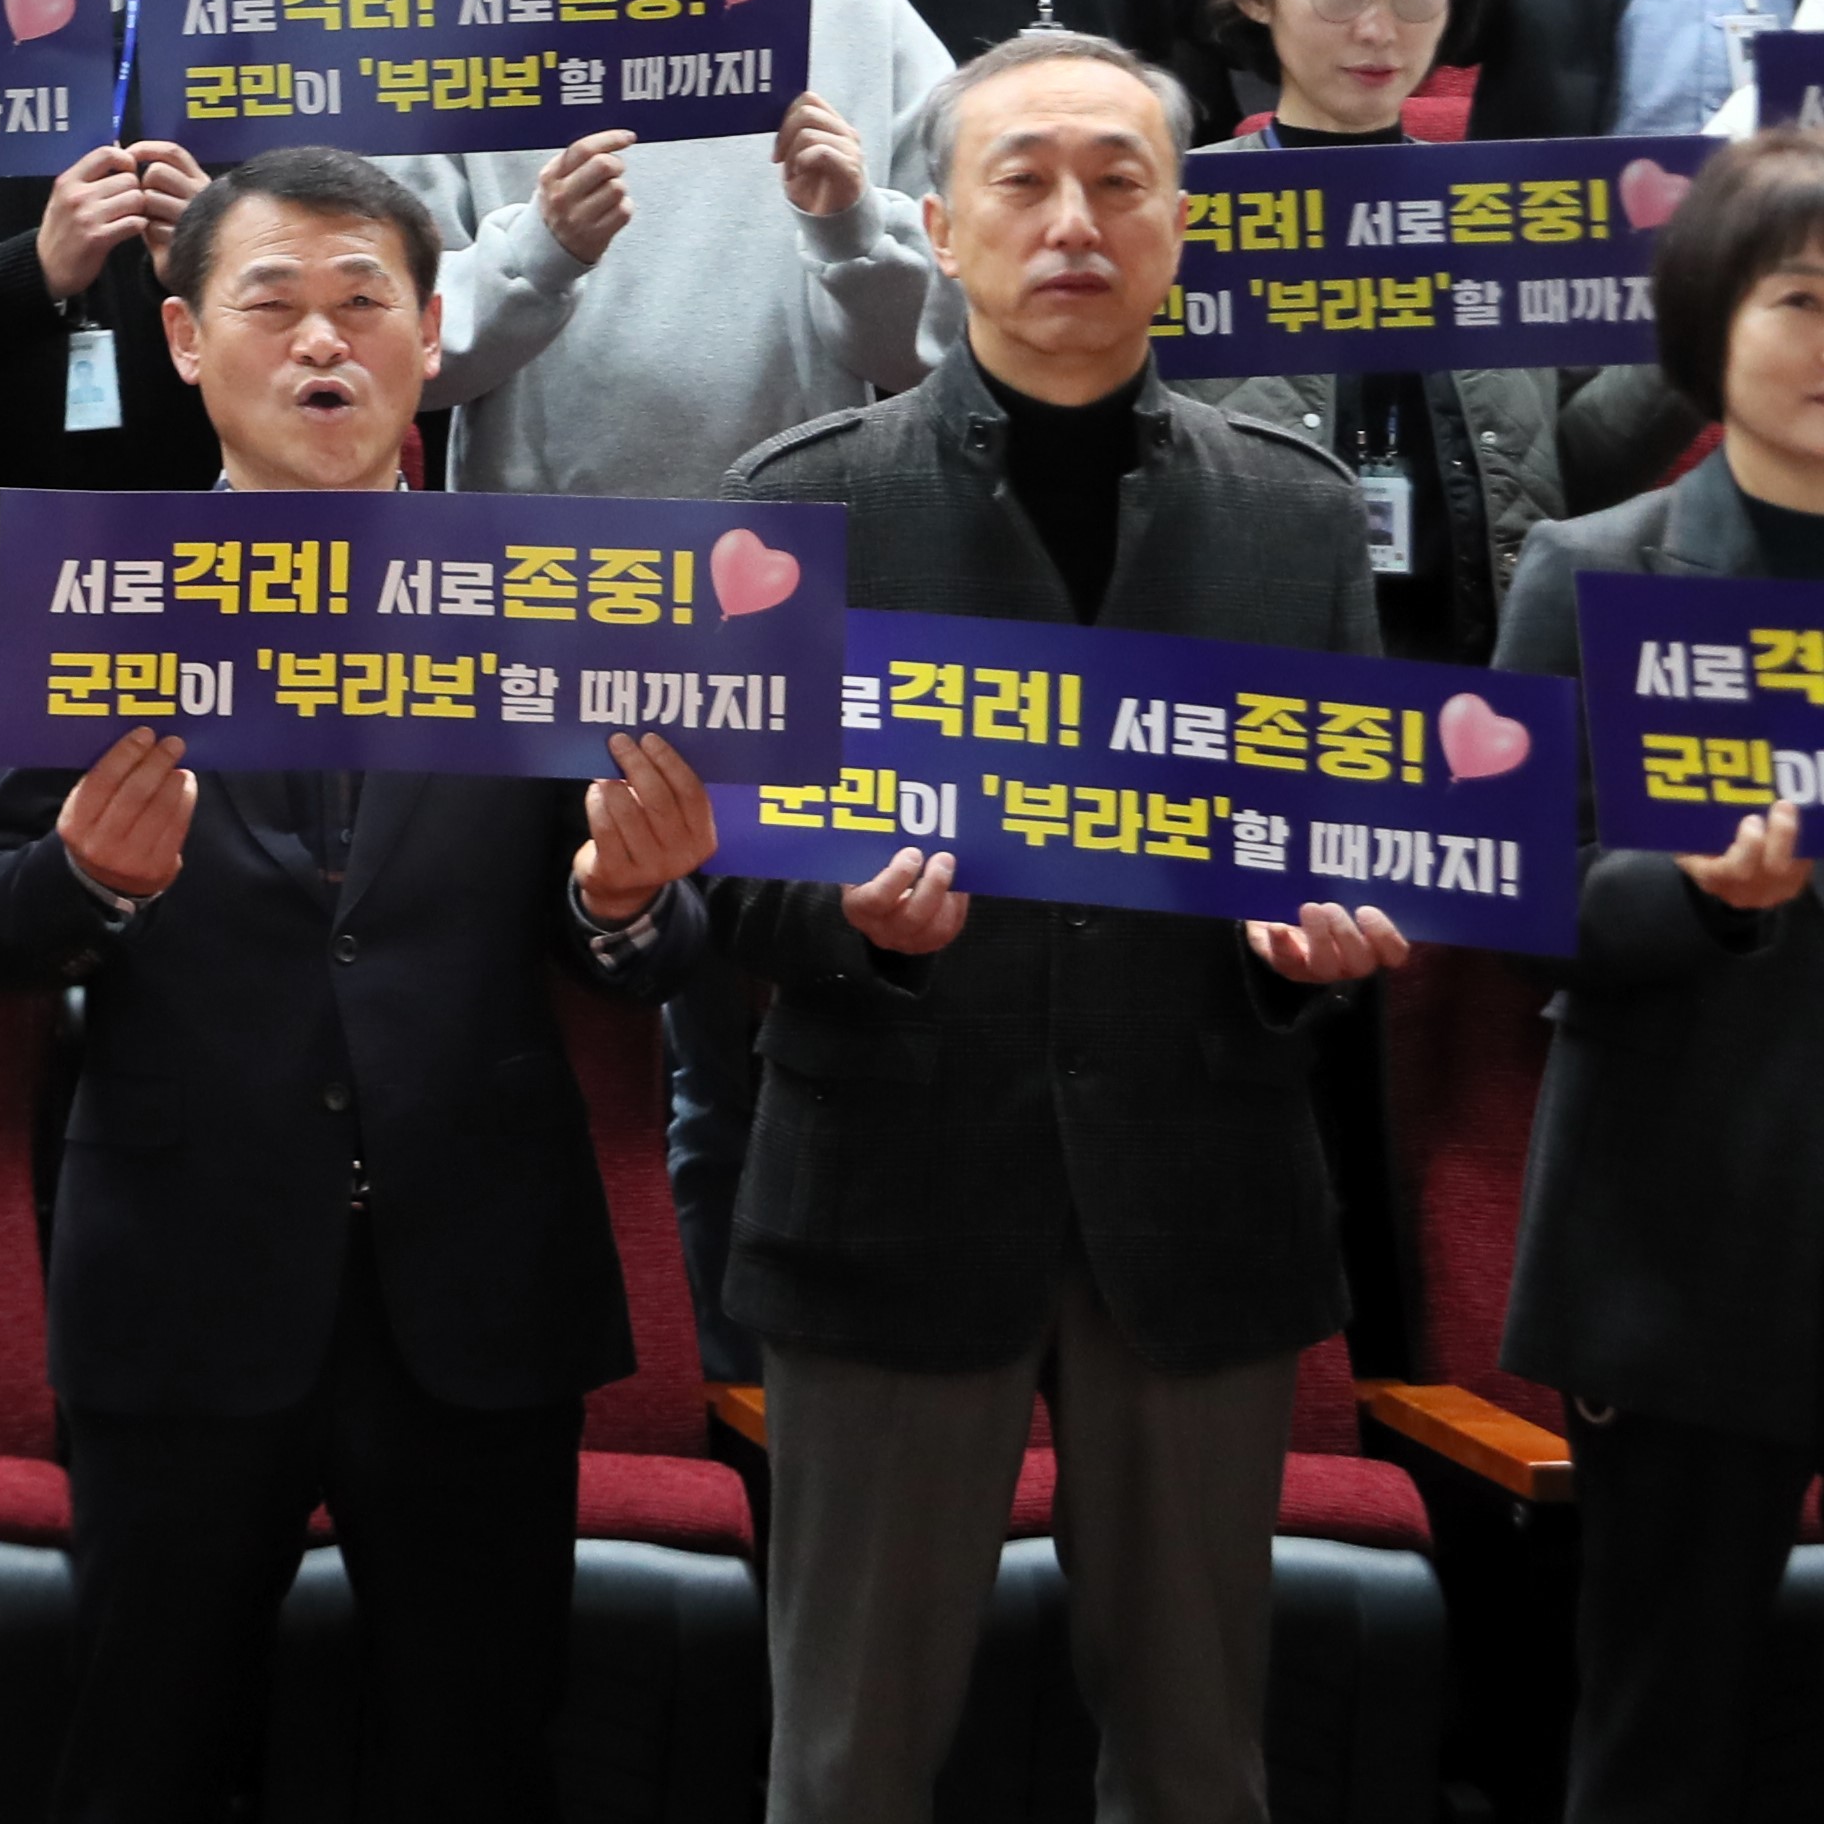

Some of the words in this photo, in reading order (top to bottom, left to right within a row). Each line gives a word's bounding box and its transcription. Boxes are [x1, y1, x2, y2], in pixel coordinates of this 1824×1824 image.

[185, 62, 342, 120] 군민이
[360, 49, 605, 112] '부라보'할
[619, 48, 772, 99] 때까지!
[1184, 188, 1325, 252] 격려!
[1346, 178, 1609, 247] 서로존중!
[1250, 271, 1501, 333] '부라보'할
[50, 540, 350, 614] 서로격려!
[377, 544, 695, 625] 서로존중!
[47, 651, 234, 718] 군민이
[256, 651, 559, 724] '부라보'할
[579, 666, 787, 731] 때까지!
[841, 659, 1082, 747] 로격려!
[1110, 691, 1425, 784] 서로존중!
[982, 772, 1290, 872] '부라보'할
[1309, 821, 1521, 898] 때까지!
